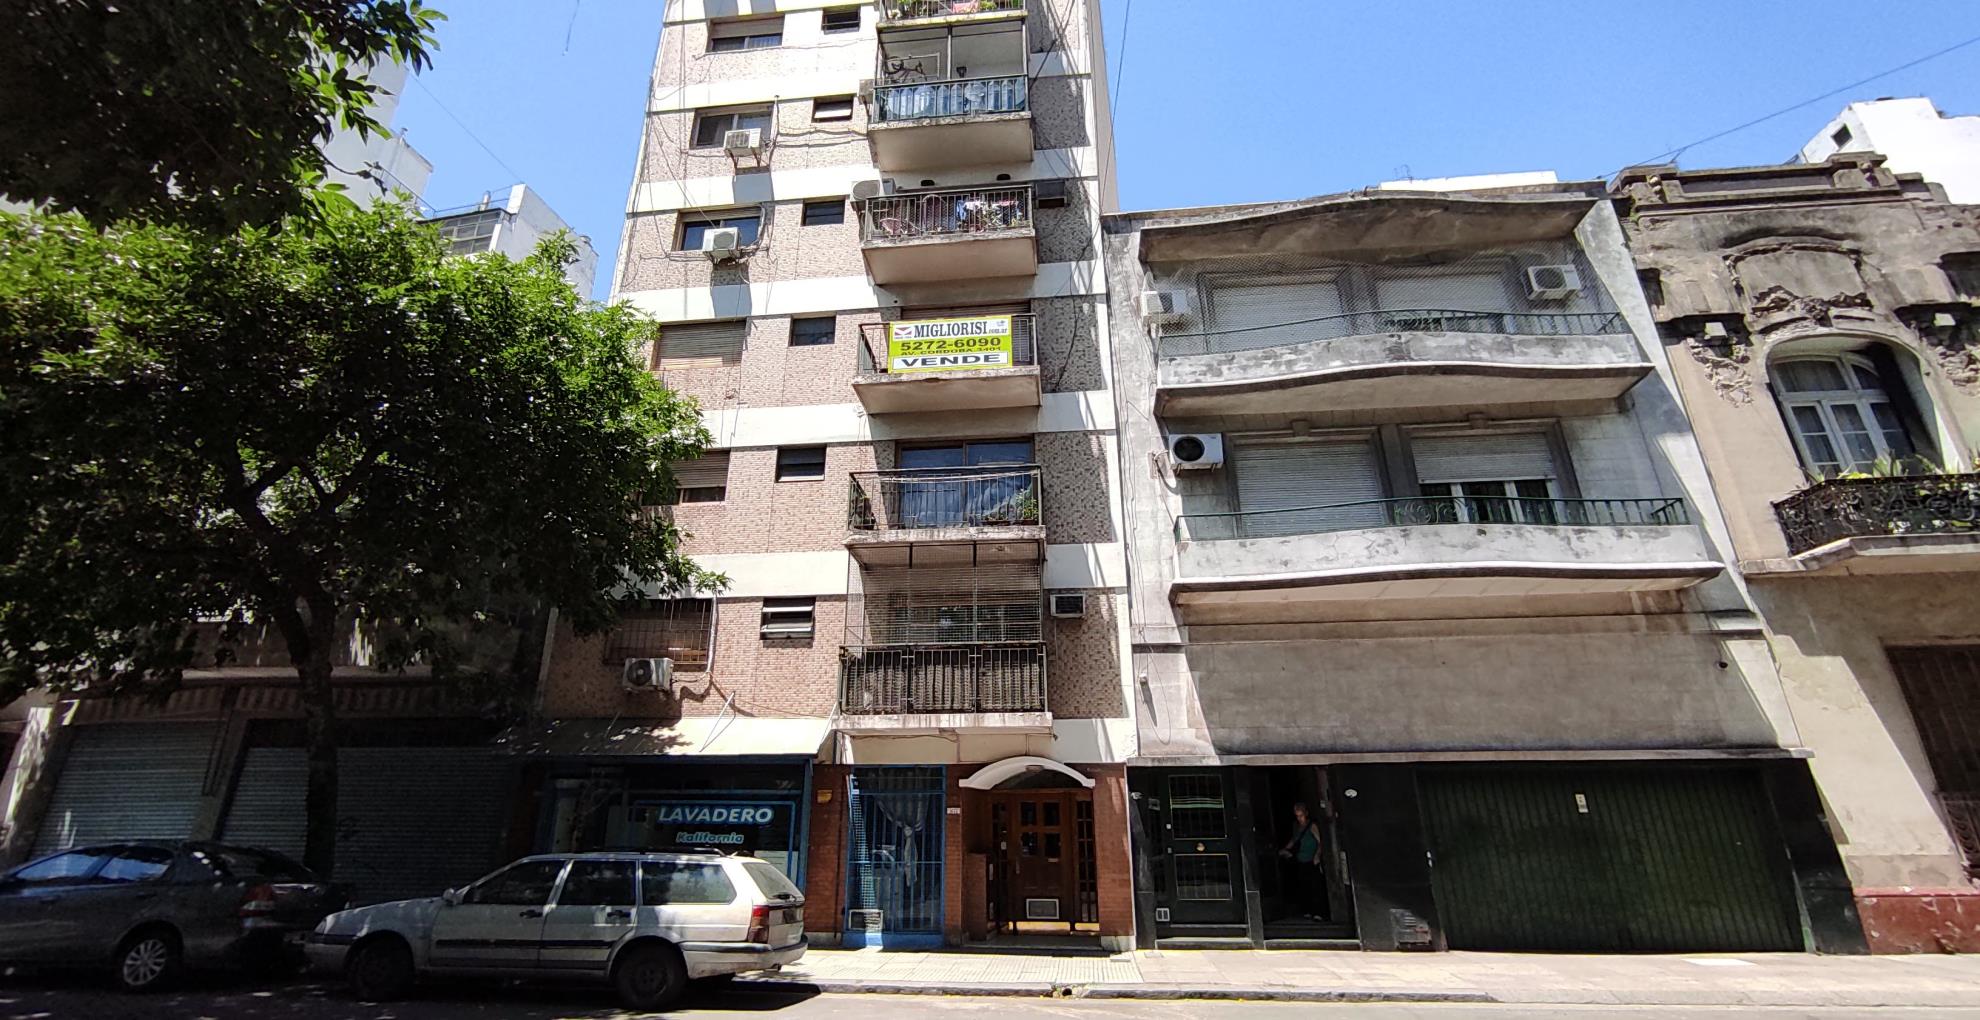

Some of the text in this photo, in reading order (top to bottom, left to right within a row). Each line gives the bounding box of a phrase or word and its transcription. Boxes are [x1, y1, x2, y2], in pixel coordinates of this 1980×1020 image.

[914, 321, 988, 338] MIGLIORISI
[901, 337, 1001, 351] 5272-6090
[901, 354, 1001, 367] VENDE
[659, 807, 773, 822] LAVADERO
[676, 832, 744, 844] Kalifornia
